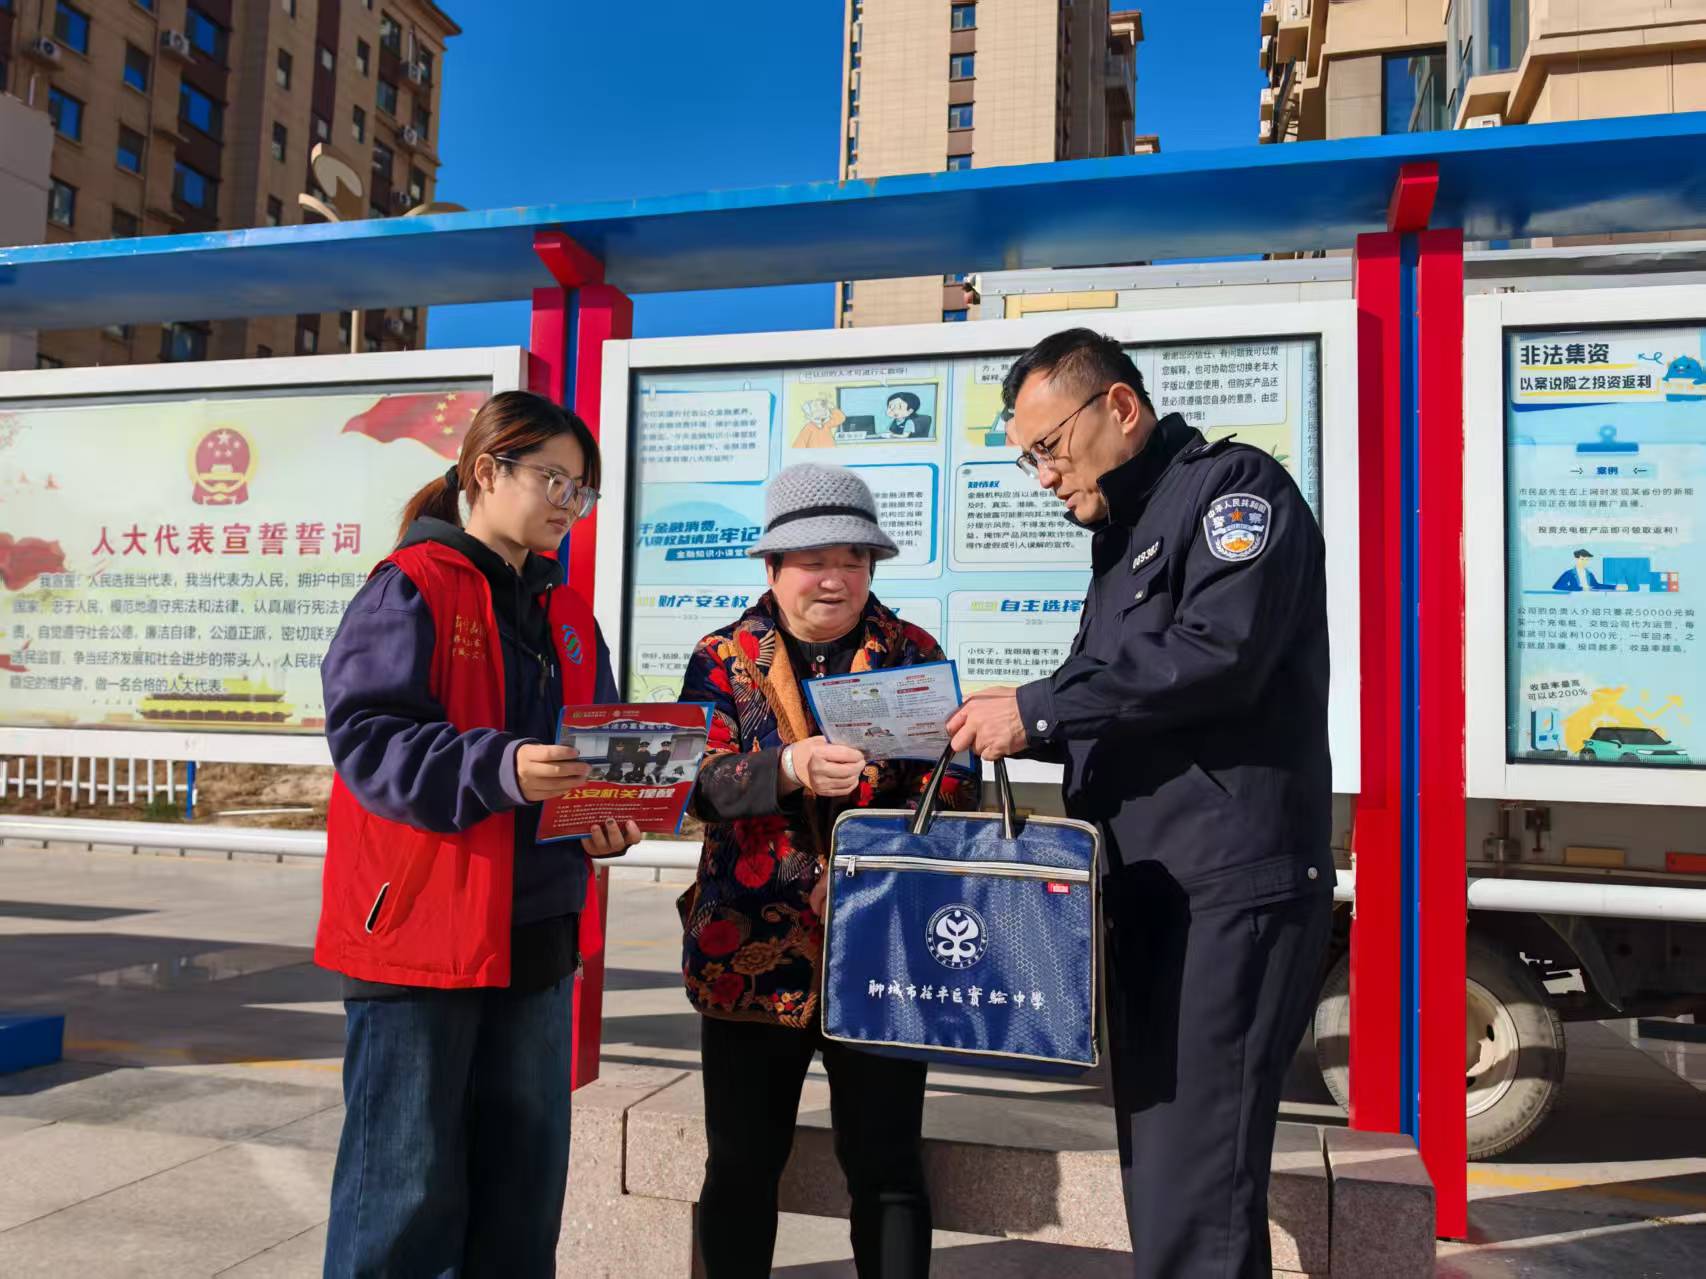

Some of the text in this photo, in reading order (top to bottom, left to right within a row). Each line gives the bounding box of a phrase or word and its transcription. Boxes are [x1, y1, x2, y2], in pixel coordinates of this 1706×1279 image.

[1520, 343, 1609, 365] 非法集资
[1520, 374, 1651, 391] 以案说险之投资返利
[1596, 466, 1618, 475] 案例
[1208, 498, 1267, 518] 中华人民共和国
[91, 522, 361, 556] 人大代表宣誓誓词
[720, 526, 761, 543] 牢记
[658, 595, 749, 608] 财产安全权
[1000, 599, 1087, 612] 自主选择
[1528, 688, 1588, 700] 可以达200%
[562, 788, 676, 800] 公安机关提醒
